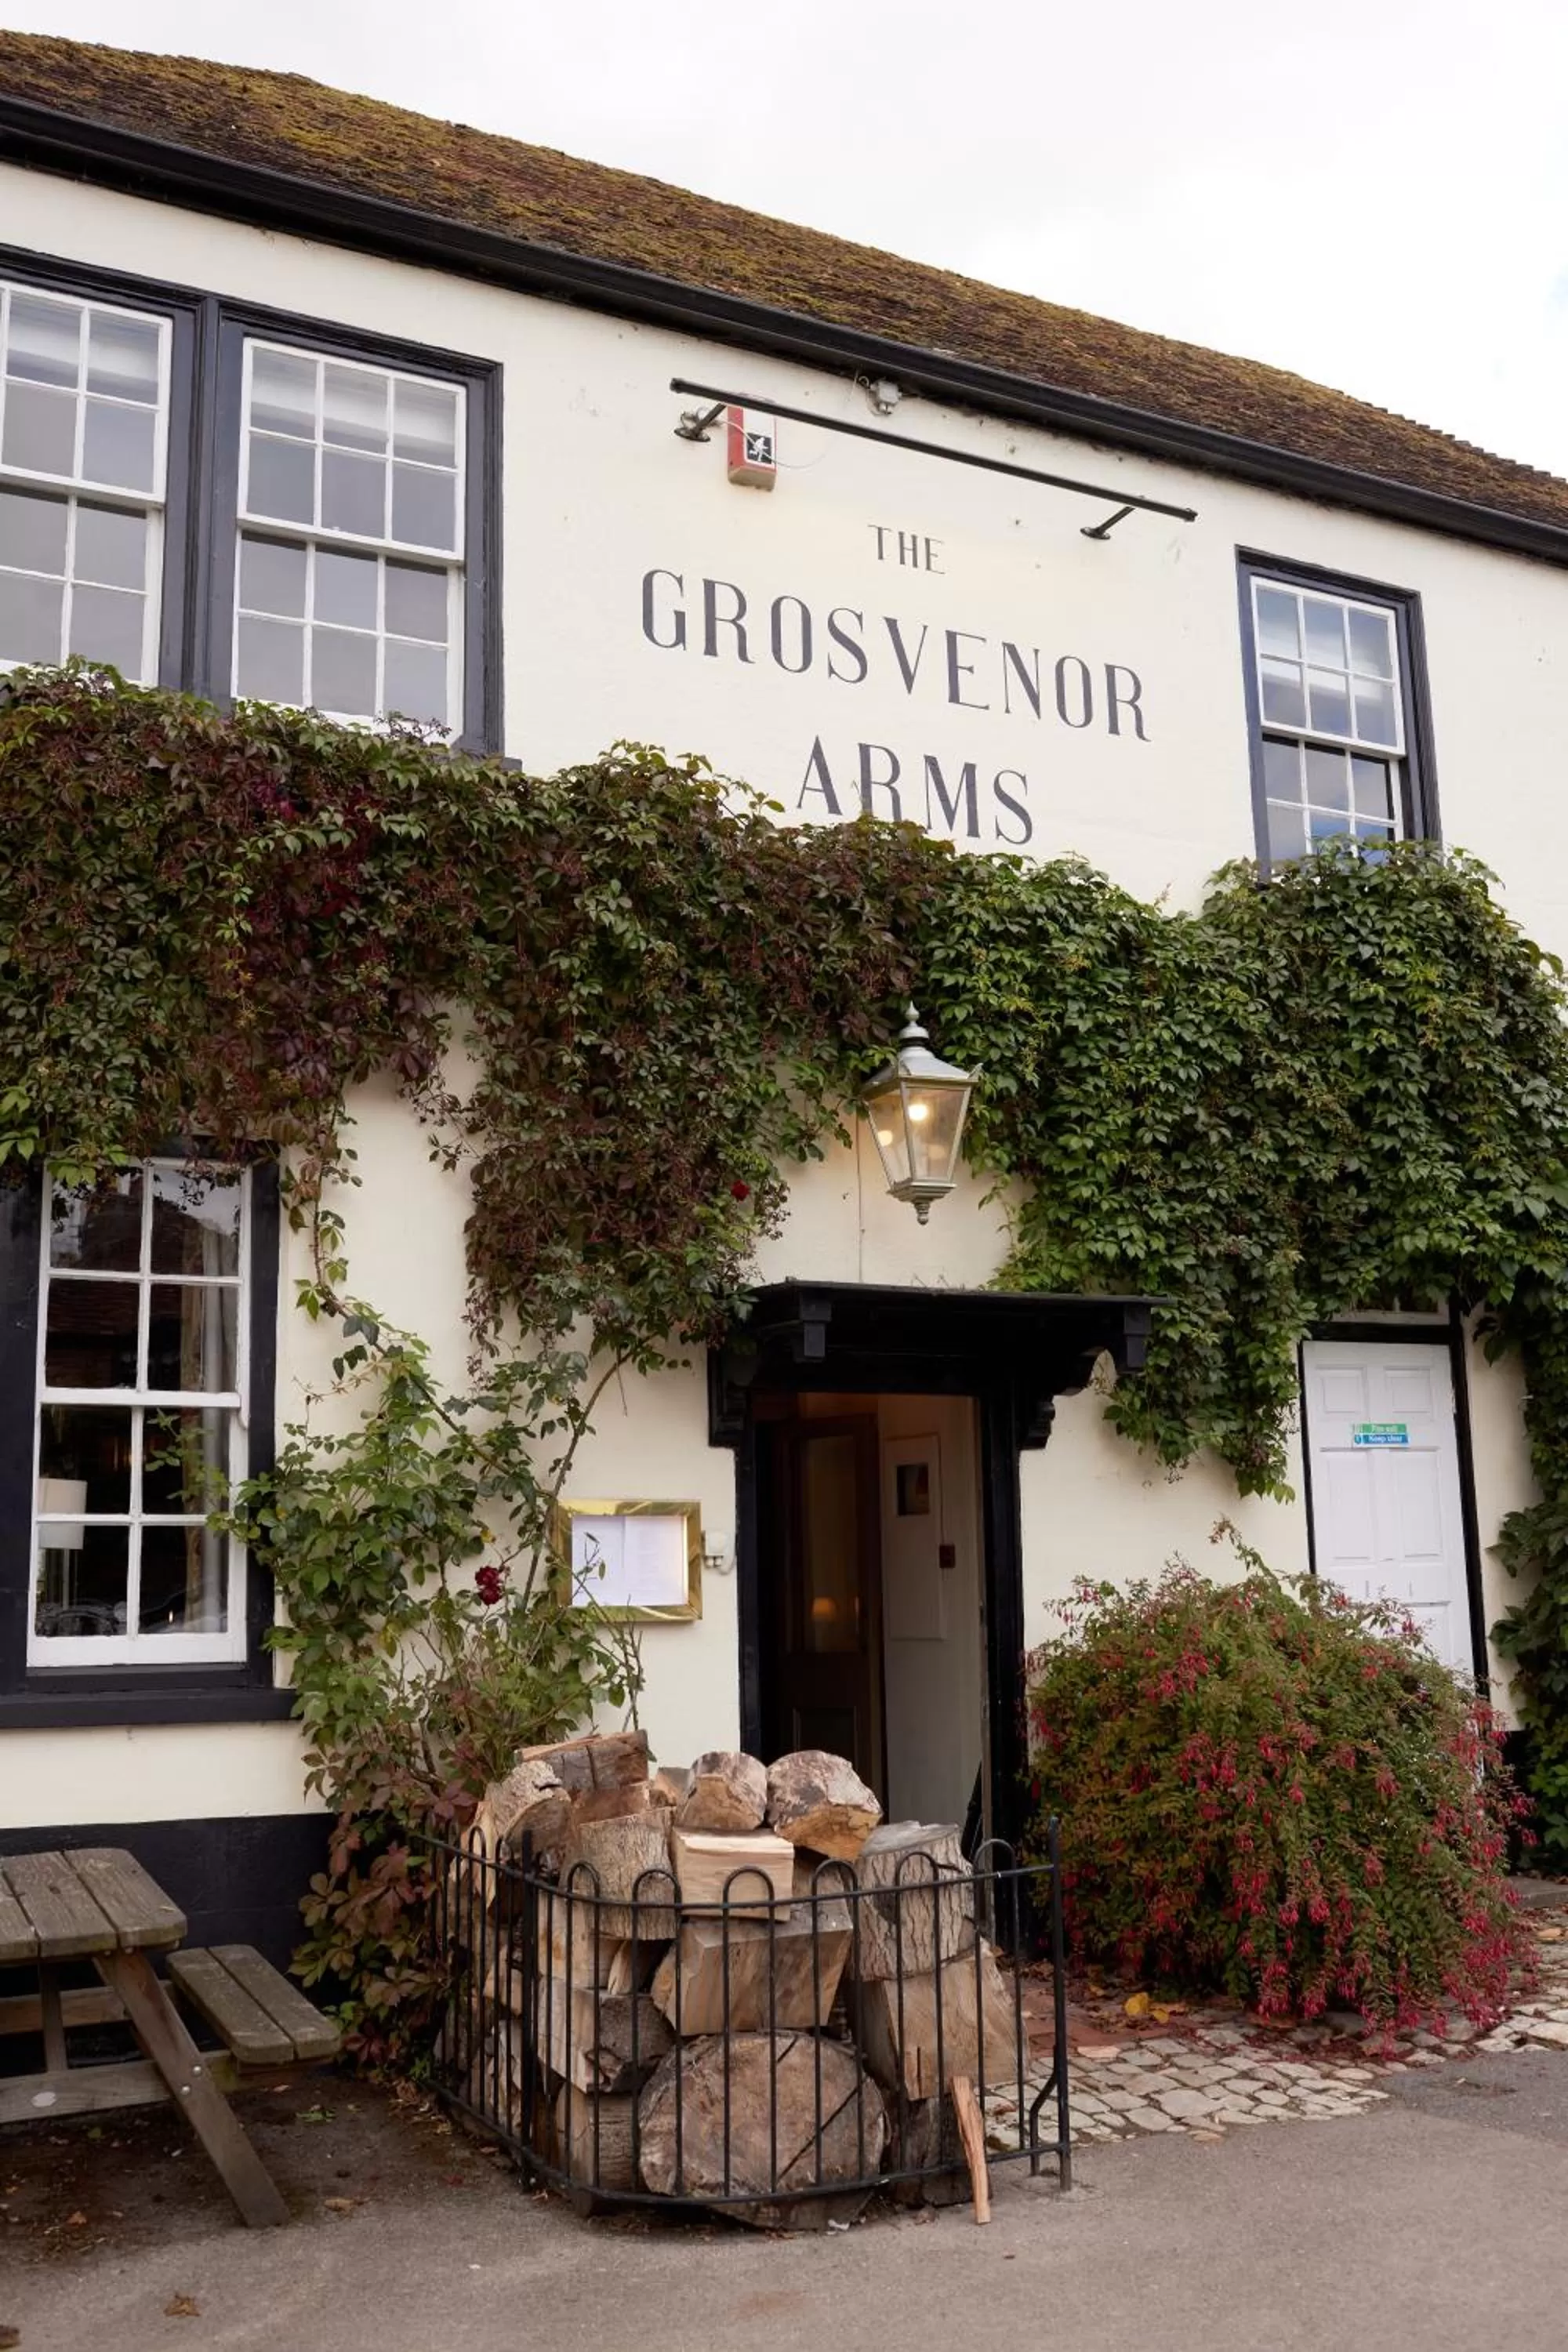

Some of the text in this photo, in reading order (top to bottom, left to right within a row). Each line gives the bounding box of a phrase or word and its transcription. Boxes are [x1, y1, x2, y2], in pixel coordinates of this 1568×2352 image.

[867, 524, 946, 575] THE
[641, 568, 1152, 742] GROSVENOR
[796, 735, 1033, 845] ARMS
